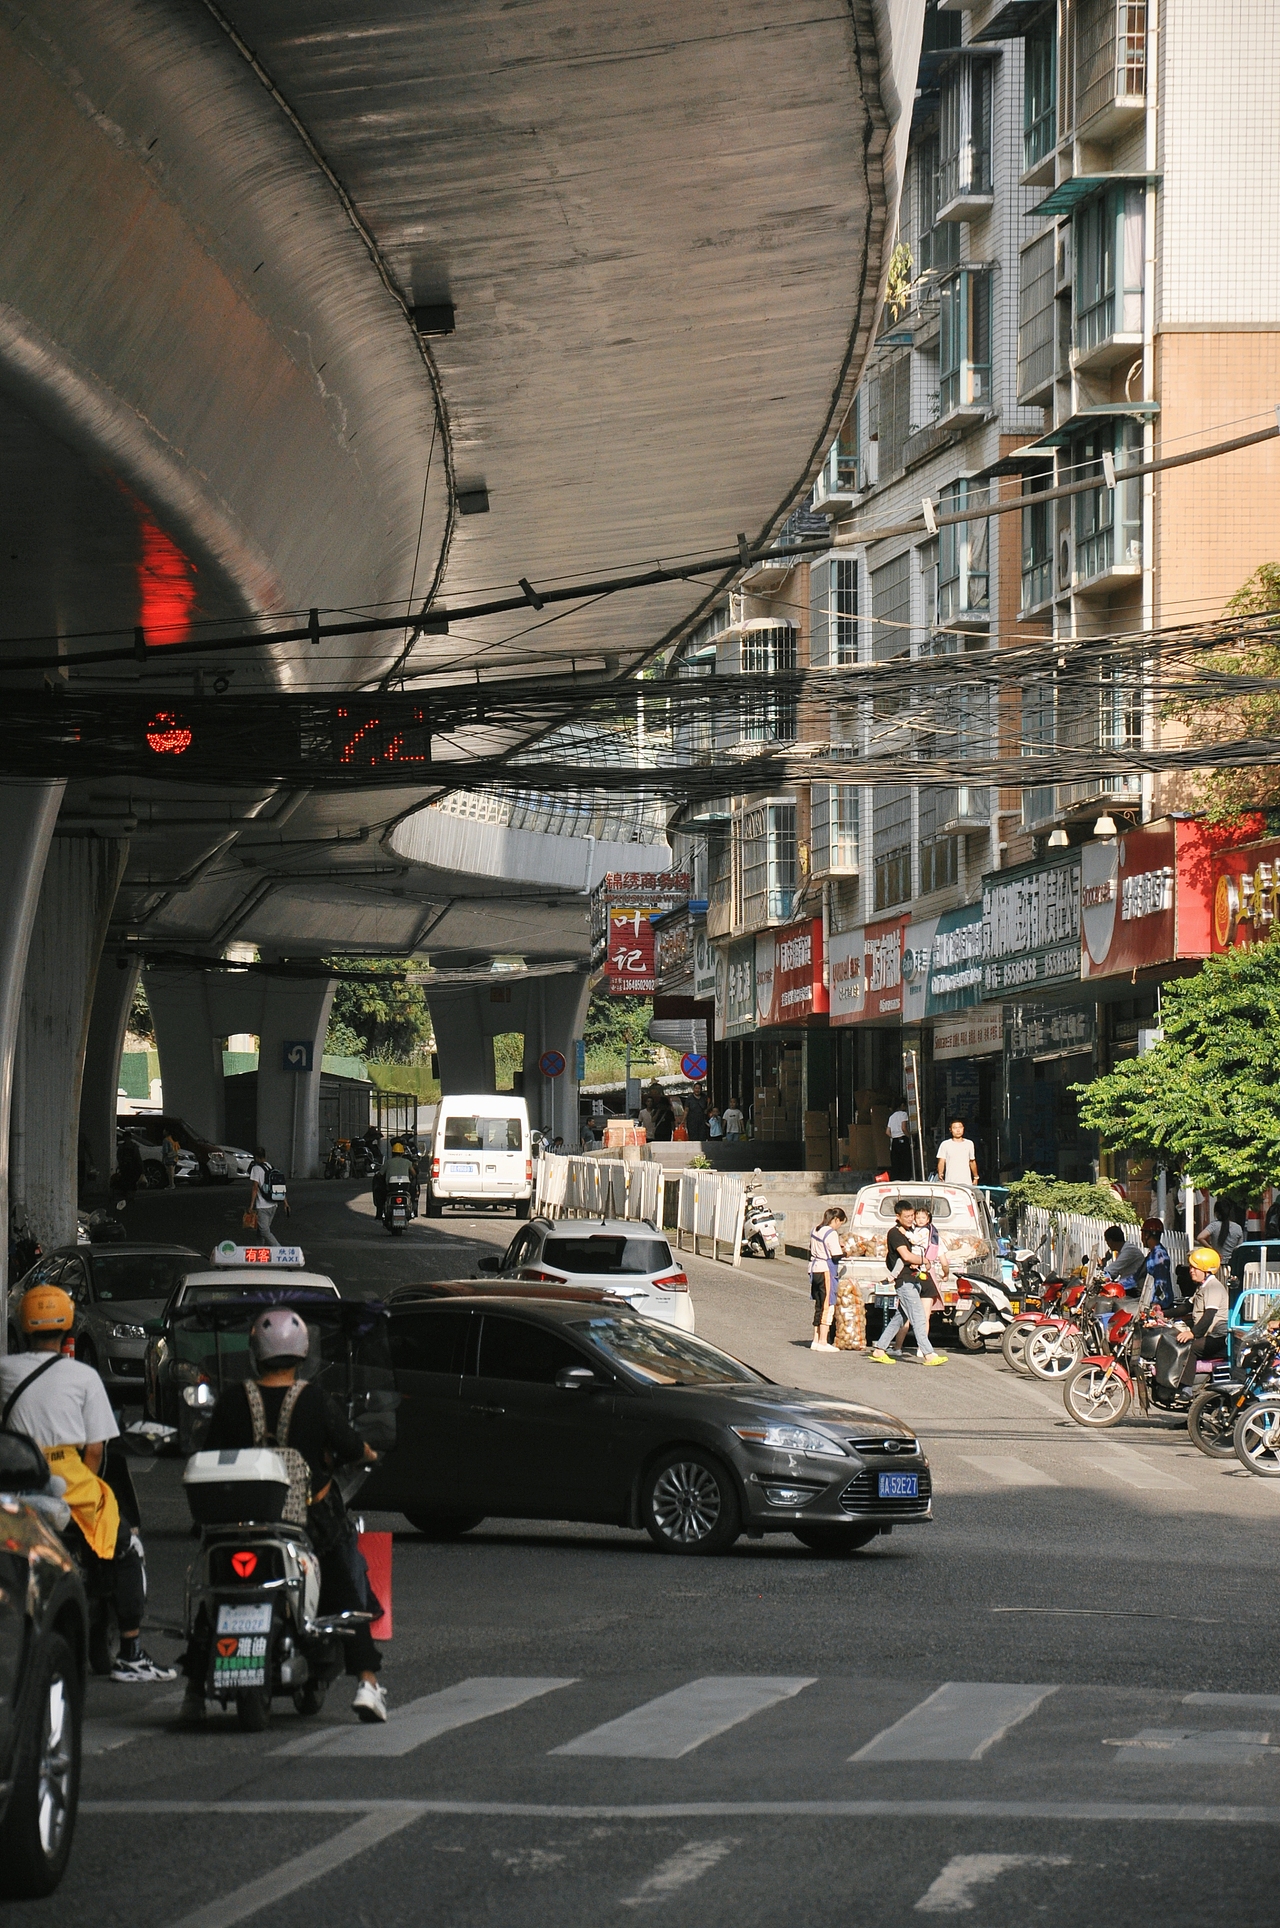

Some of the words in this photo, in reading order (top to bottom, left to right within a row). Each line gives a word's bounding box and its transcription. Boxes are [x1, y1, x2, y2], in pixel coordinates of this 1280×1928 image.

[605, 871, 690, 890] 锦绣商务楼
[612, 910, 647, 972] 叶记
[245, 1248, 271, 1263] 有客
[236, 1635, 267, 1656] 雅迪
